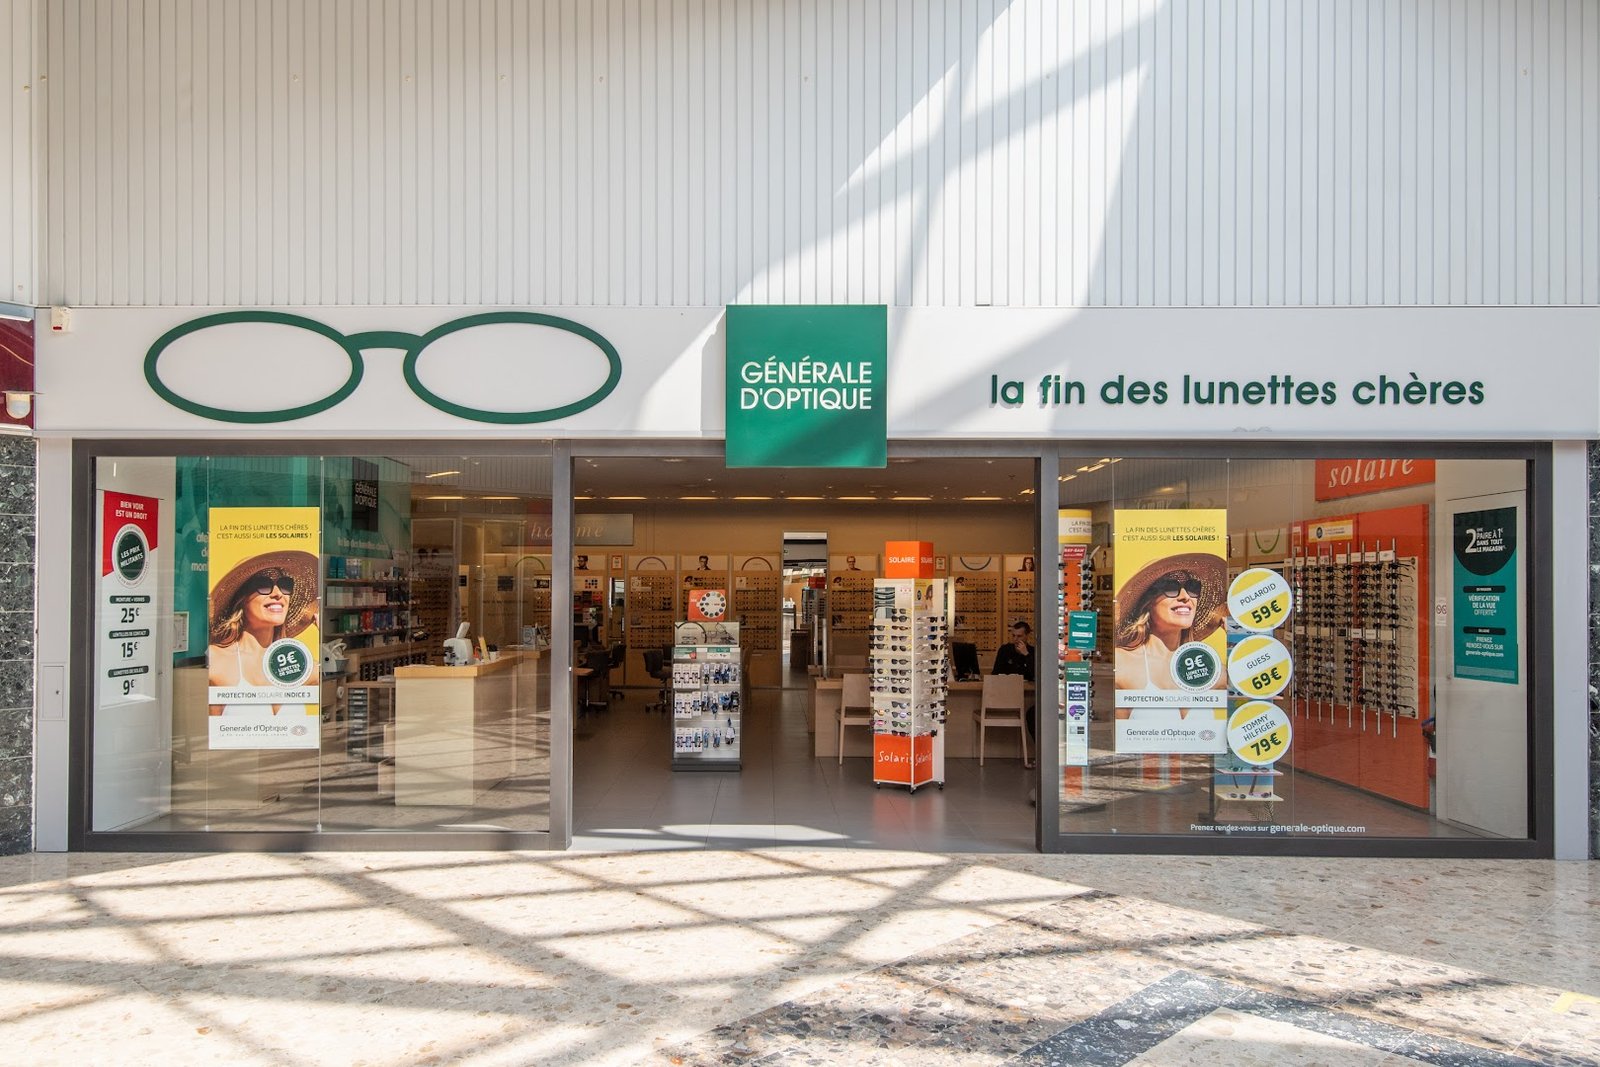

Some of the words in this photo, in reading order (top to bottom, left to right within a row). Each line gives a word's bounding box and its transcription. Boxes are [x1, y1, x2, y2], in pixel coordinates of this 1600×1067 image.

[741, 355, 872, 384] GÉNÉRALE
[992, 374, 1024, 404] la
[1041, 374, 1085, 404] fin
[1100, 374, 1168, 404] des
[1183, 374, 1337, 405] lunettes
[1352, 372, 1485, 405] chères
[740, 387, 872, 410] D'OPTIQUE
[1328, 459, 1414, 488] solaire
[120, 500, 132, 509] BIEN
[133, 512, 148, 520] DROIT
[1476, 531, 1492, 540] PAIRE
[1490, 538, 1503, 546] TOUT
[120, 549, 130, 559] LES
[129, 545, 141, 557] PRIX
[120, 552, 144, 568] MILITANTS
[888, 556, 916, 564] SOLAIRE
[1239, 583, 1276, 606] POLAROID
[1468, 594, 1500, 602] VÉRIFICATION
[121, 607, 140, 623] 25€
[1251, 599, 1282, 624] 59€
[121, 641, 138, 658] 15€
[1466, 642, 1494, 650] RENDEZ-VOUS
[277, 664, 300, 673] LUNETTES
[1246, 653, 1271, 670] GUESS
[1185, 668, 1208, 677] LUNETTES
[1251, 667, 1282, 690] 69€
[123, 679, 135, 696] 9€
[253, 724, 288, 733] d'Optique
[1242, 714, 1269, 733] TOMMY
[1243, 720, 1276, 742] HILFIGER
[1161, 728, 1196, 737] d'Optique
[1250, 732, 1282, 756] 79€
[1215, 824, 1257, 832] rendez-vous
[1270, 823, 1366, 834] generale-optique.com
